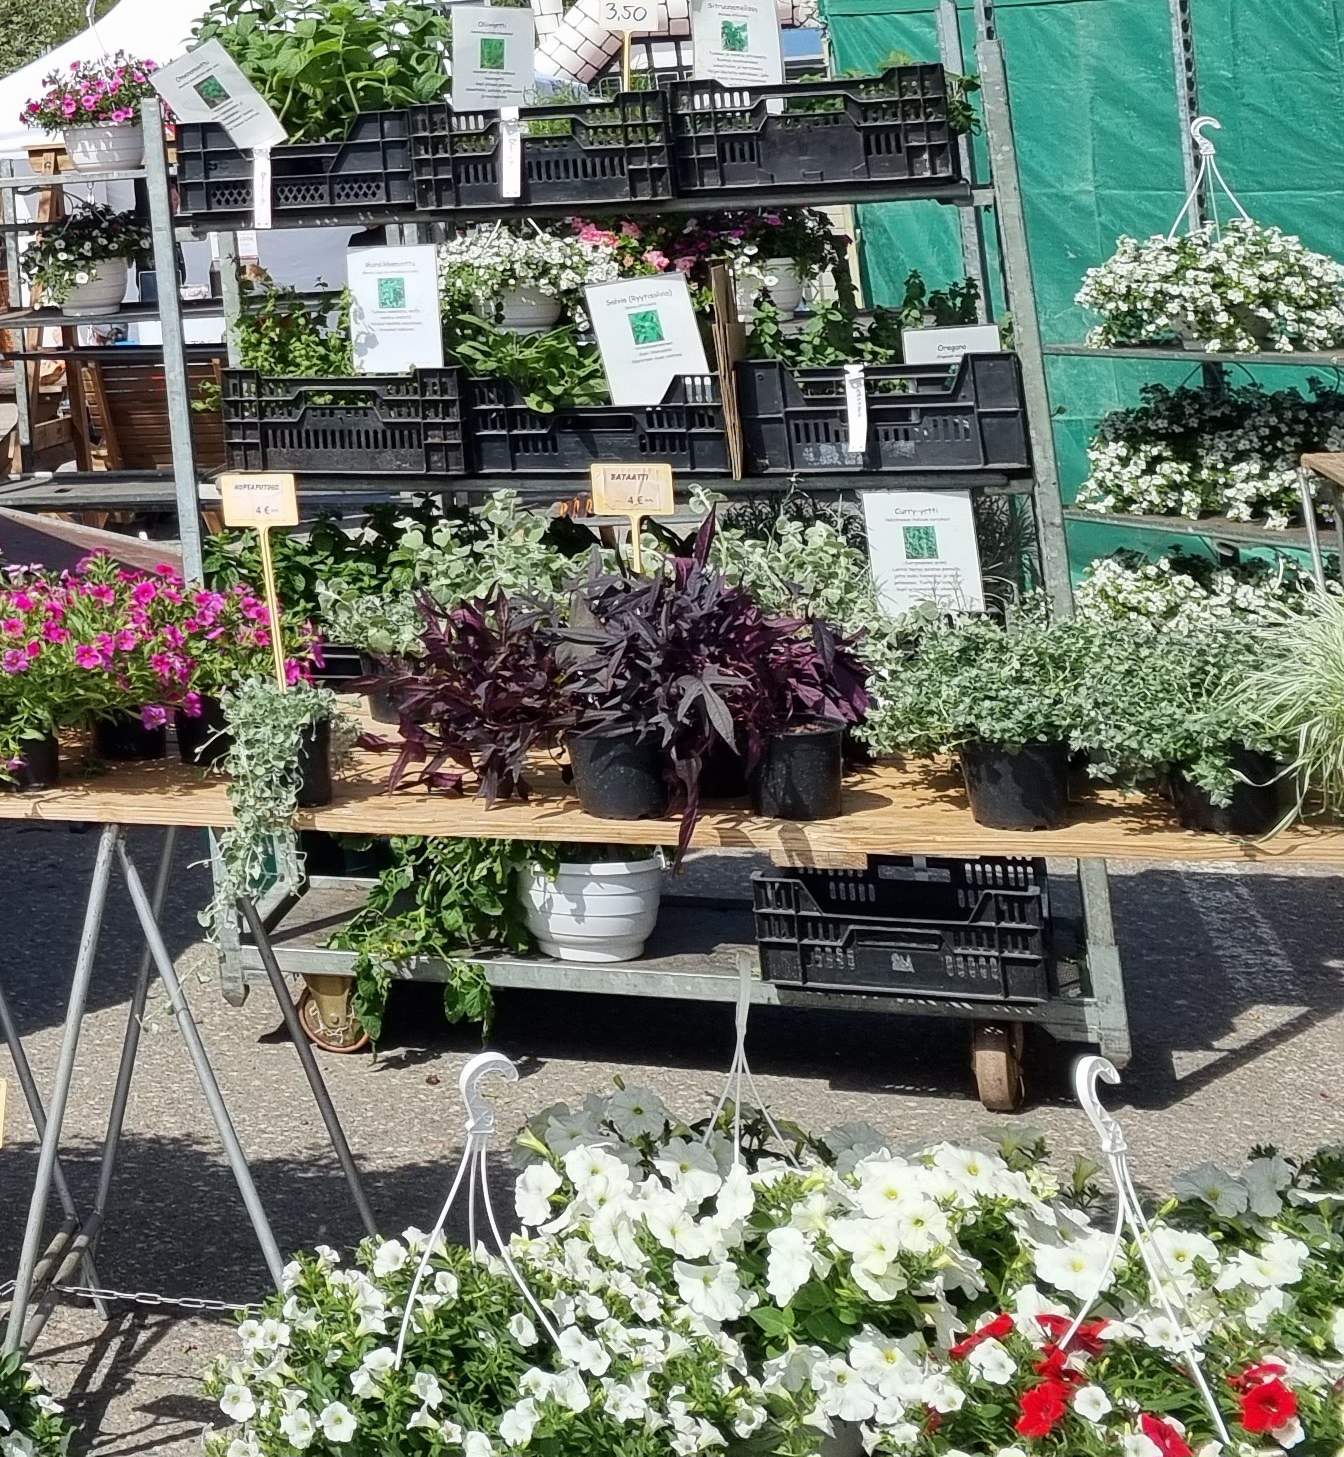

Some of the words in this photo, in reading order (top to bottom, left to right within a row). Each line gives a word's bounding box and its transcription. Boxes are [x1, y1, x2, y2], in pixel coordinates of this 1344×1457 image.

[605, 2, 648, 22] 3,50
[937, 344, 967, 352] Oregano
[610, 473, 649, 481] BATAATTI
[894, 507, 939, 516] Curry-yrtti
